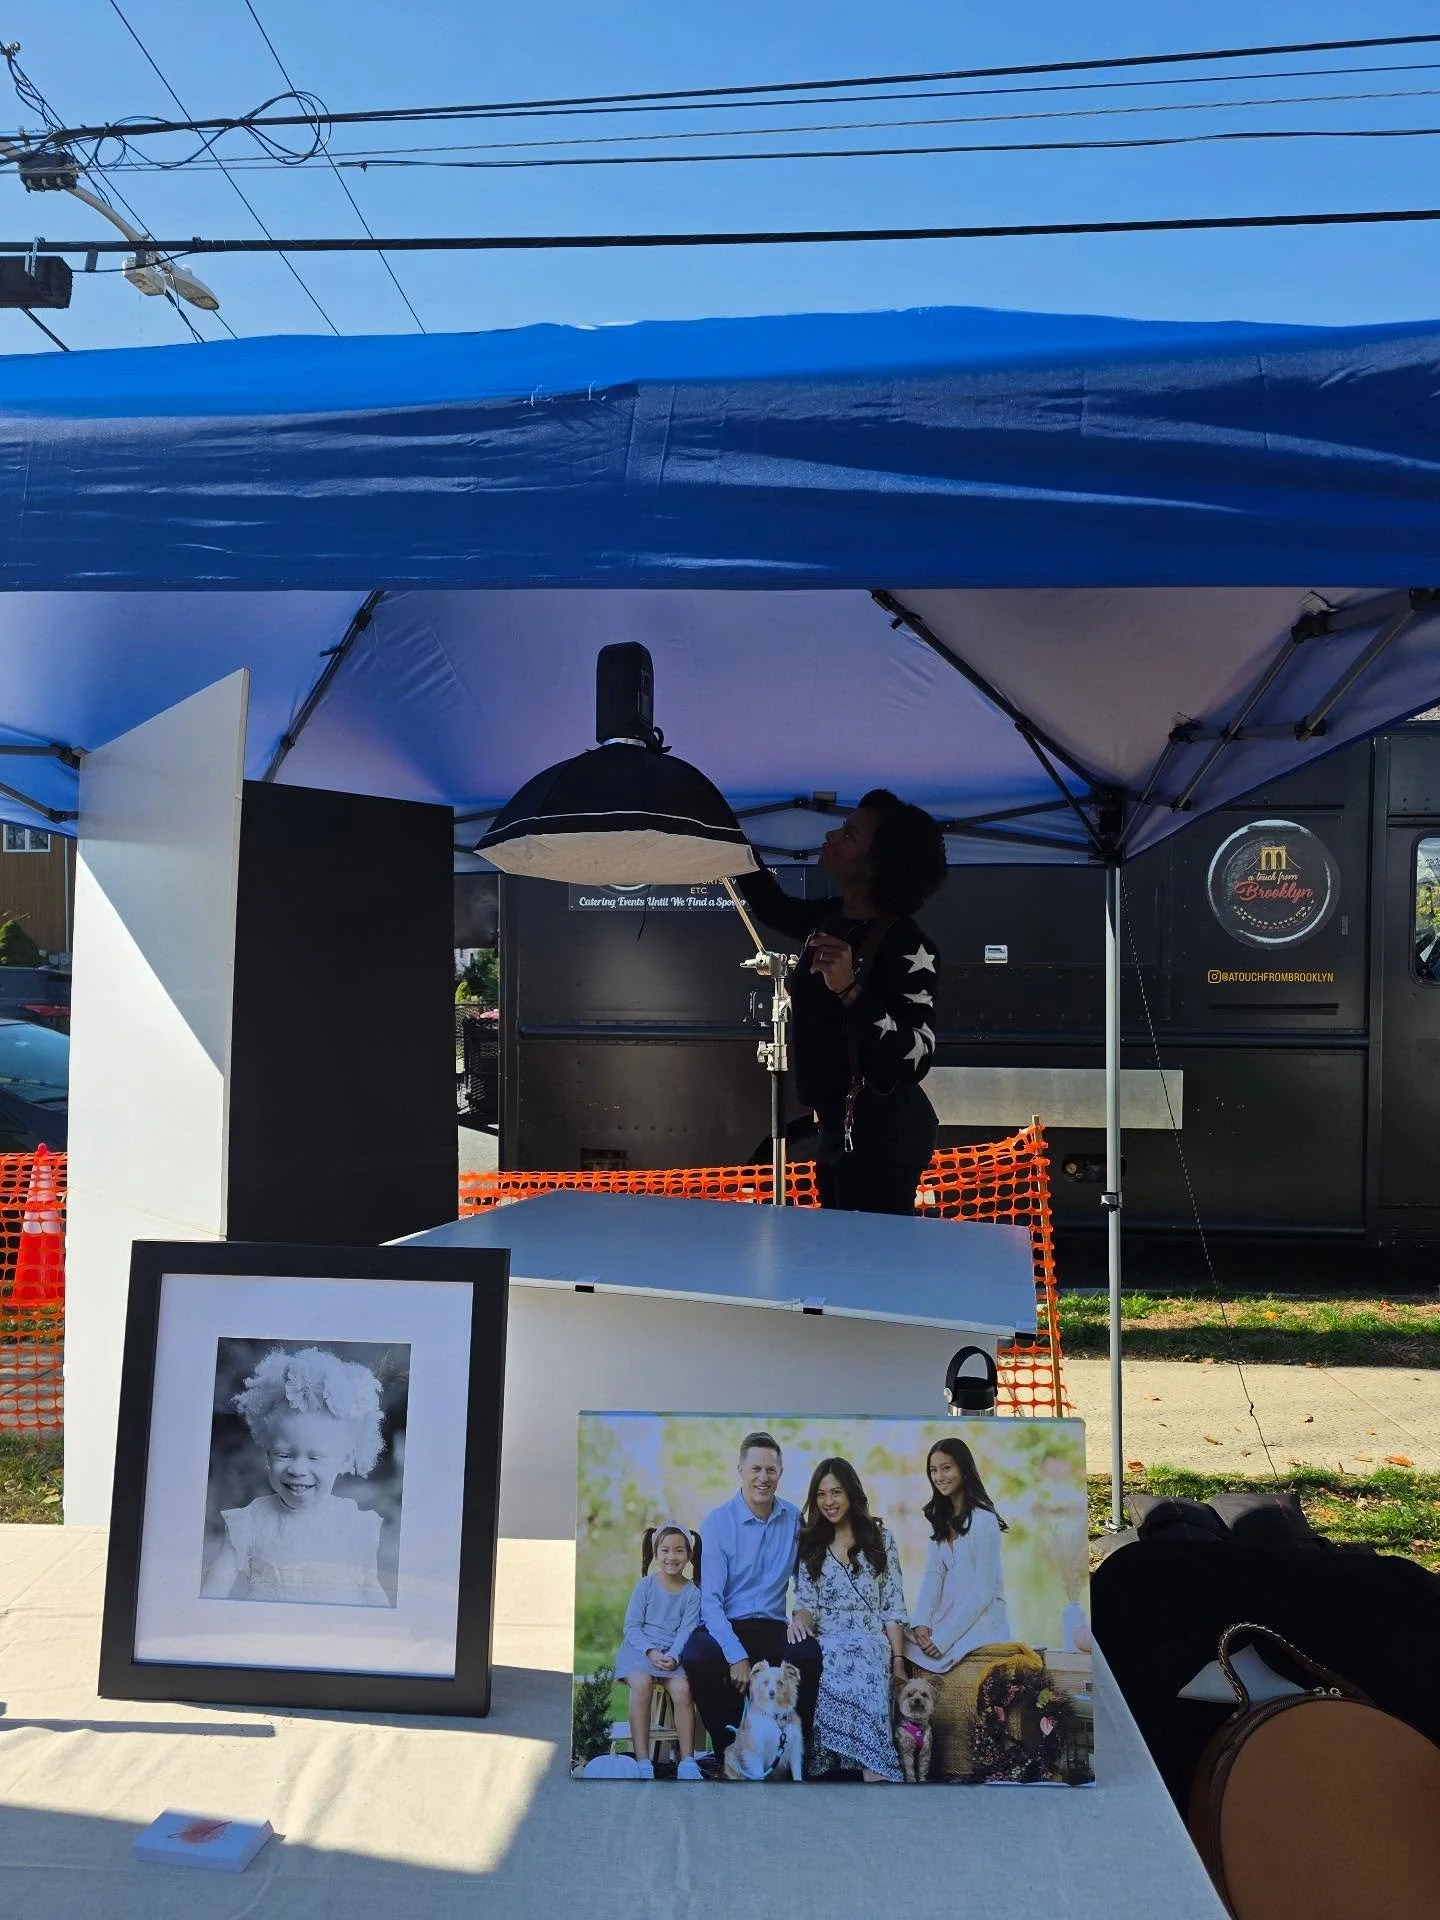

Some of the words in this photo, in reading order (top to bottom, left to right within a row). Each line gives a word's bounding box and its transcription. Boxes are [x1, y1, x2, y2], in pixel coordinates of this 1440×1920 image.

[1256, 871, 1277, 881] touch
[1276, 871, 1299, 885] from
[1233, 880, 1313, 904] Brooklyn
[579, 896, 617, 909] Catering
[617, 896, 646, 907] Events
[646, 896, 670, 907] Until
[670, 896, 686, 907] We
[686, 896, 708, 907] Find
[708, 898, 716, 907] a
[1221, 972, 1334, 983] @ATOUCHFROMBROOKLYN
